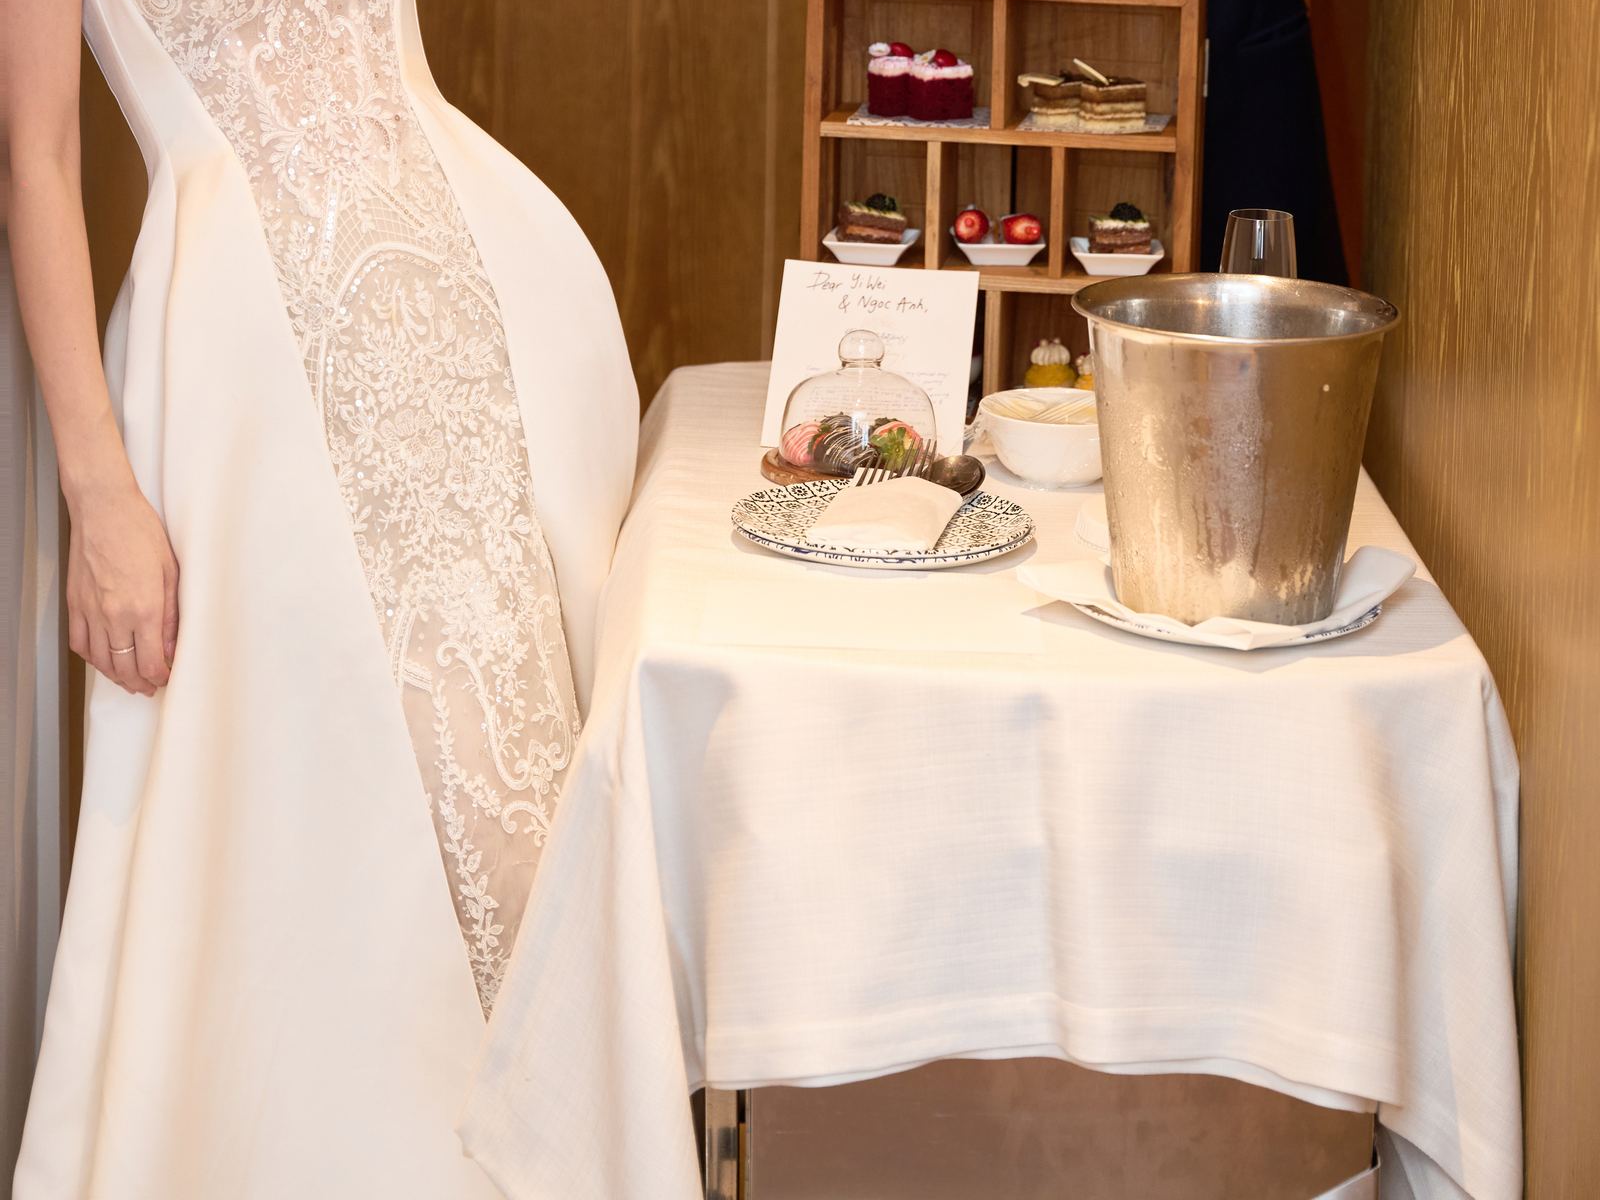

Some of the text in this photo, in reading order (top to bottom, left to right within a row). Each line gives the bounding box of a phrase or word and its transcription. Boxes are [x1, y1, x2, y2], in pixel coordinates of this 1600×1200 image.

[806, 270, 843, 291] Dear
[838, 294, 851, 314] &
[857, 295, 892, 314] Ngoc
